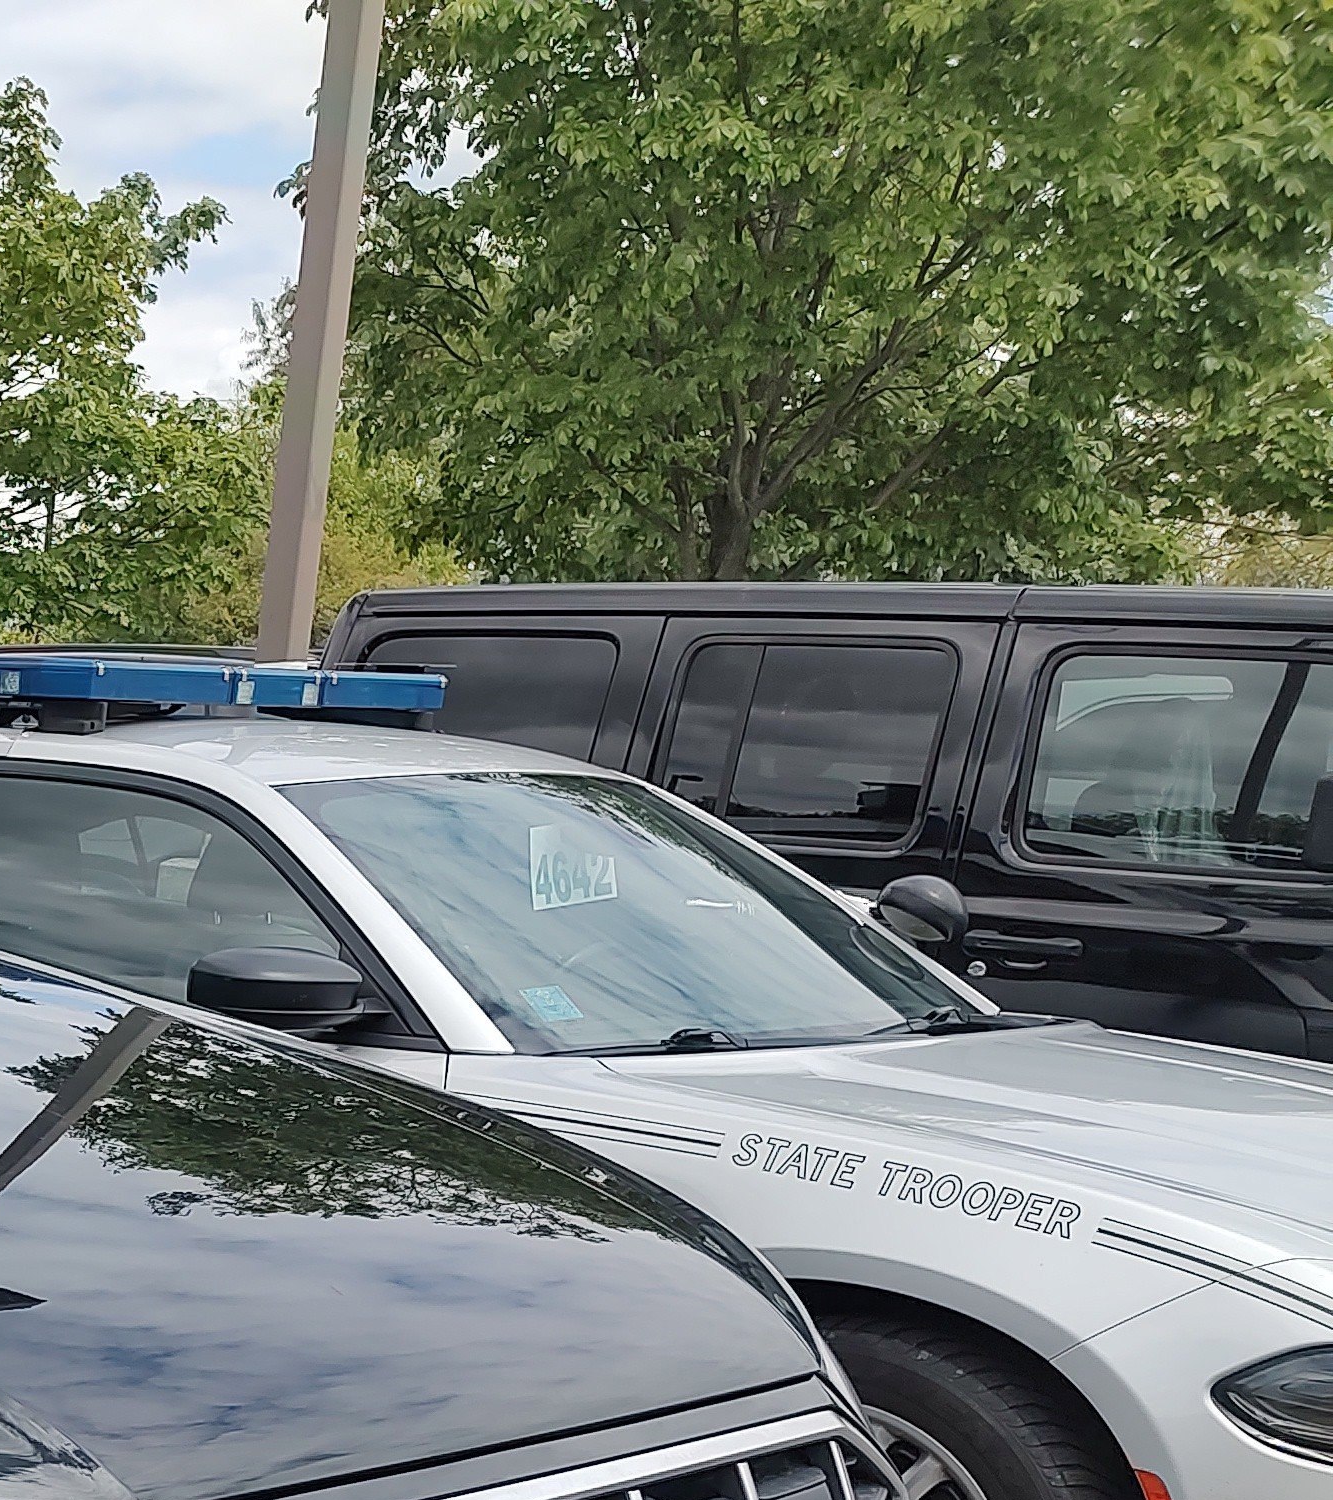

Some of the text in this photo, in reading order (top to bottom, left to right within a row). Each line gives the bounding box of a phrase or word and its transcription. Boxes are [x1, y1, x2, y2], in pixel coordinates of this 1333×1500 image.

[535, 851, 614, 905] 4642
[732, 1133, 1082, 1240] STATE TROOPER
